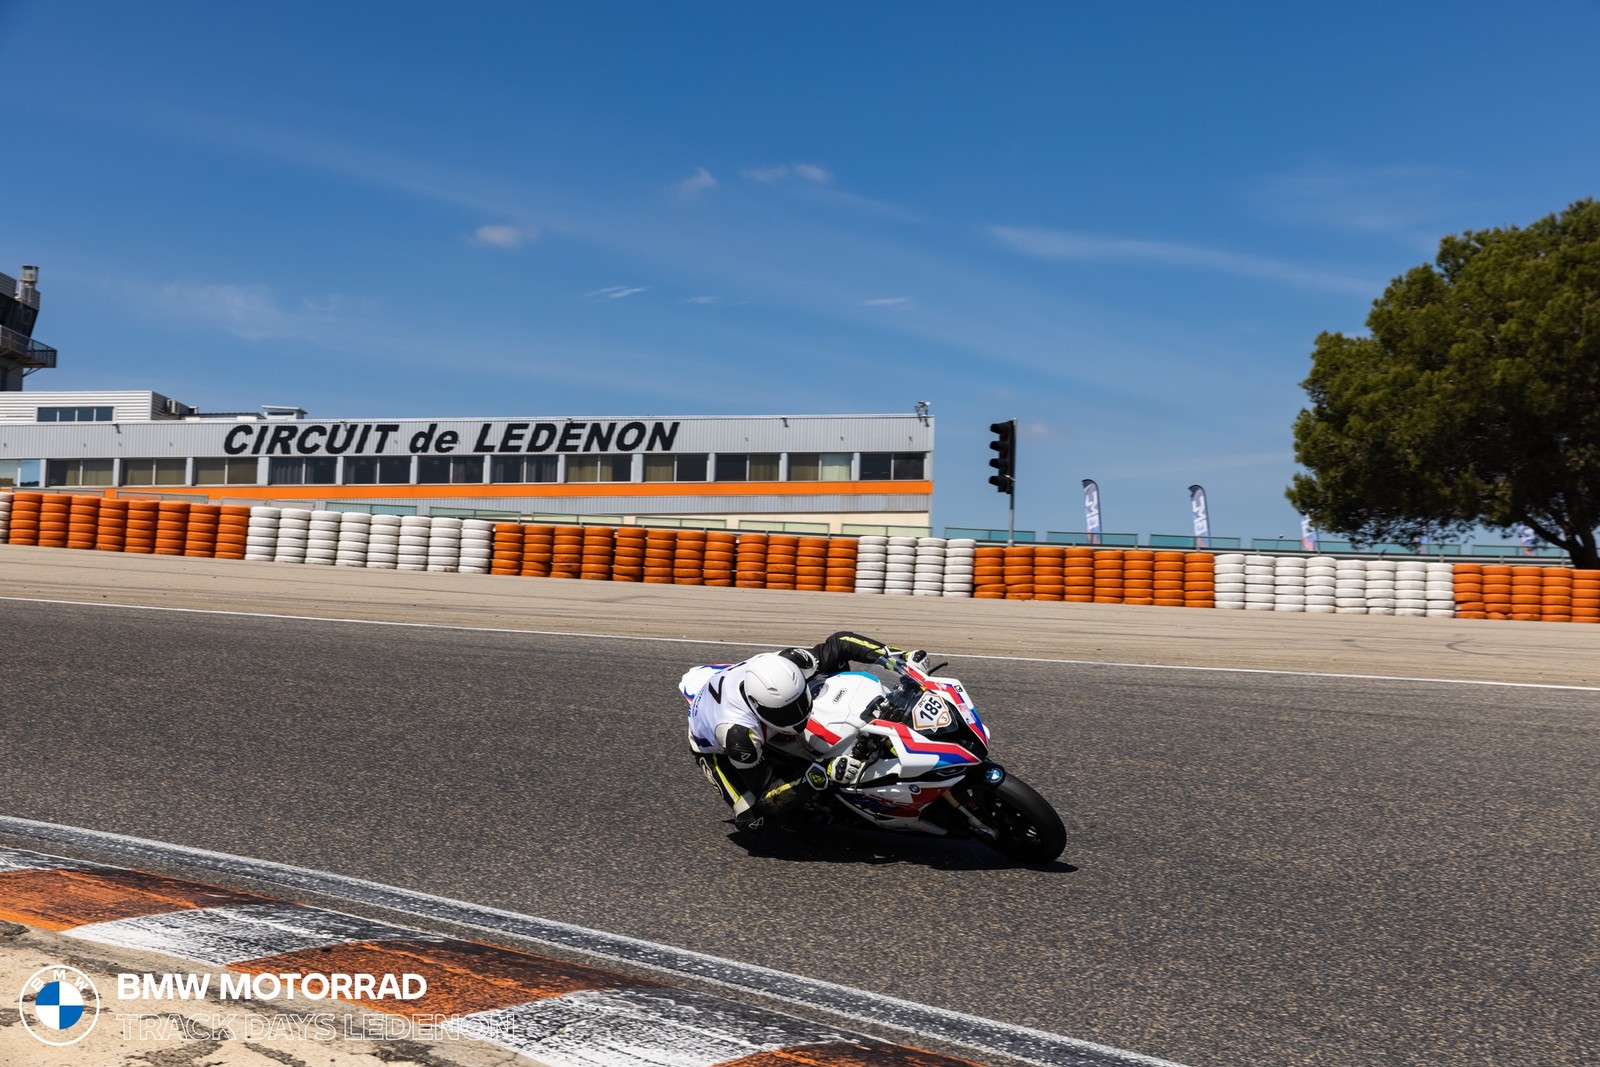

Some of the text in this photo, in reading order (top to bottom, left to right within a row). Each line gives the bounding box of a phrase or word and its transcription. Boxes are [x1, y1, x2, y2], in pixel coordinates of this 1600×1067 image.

[224, 422, 680, 455] CIRCUIT de LEDENON
[919, 697, 943, 722] 185
